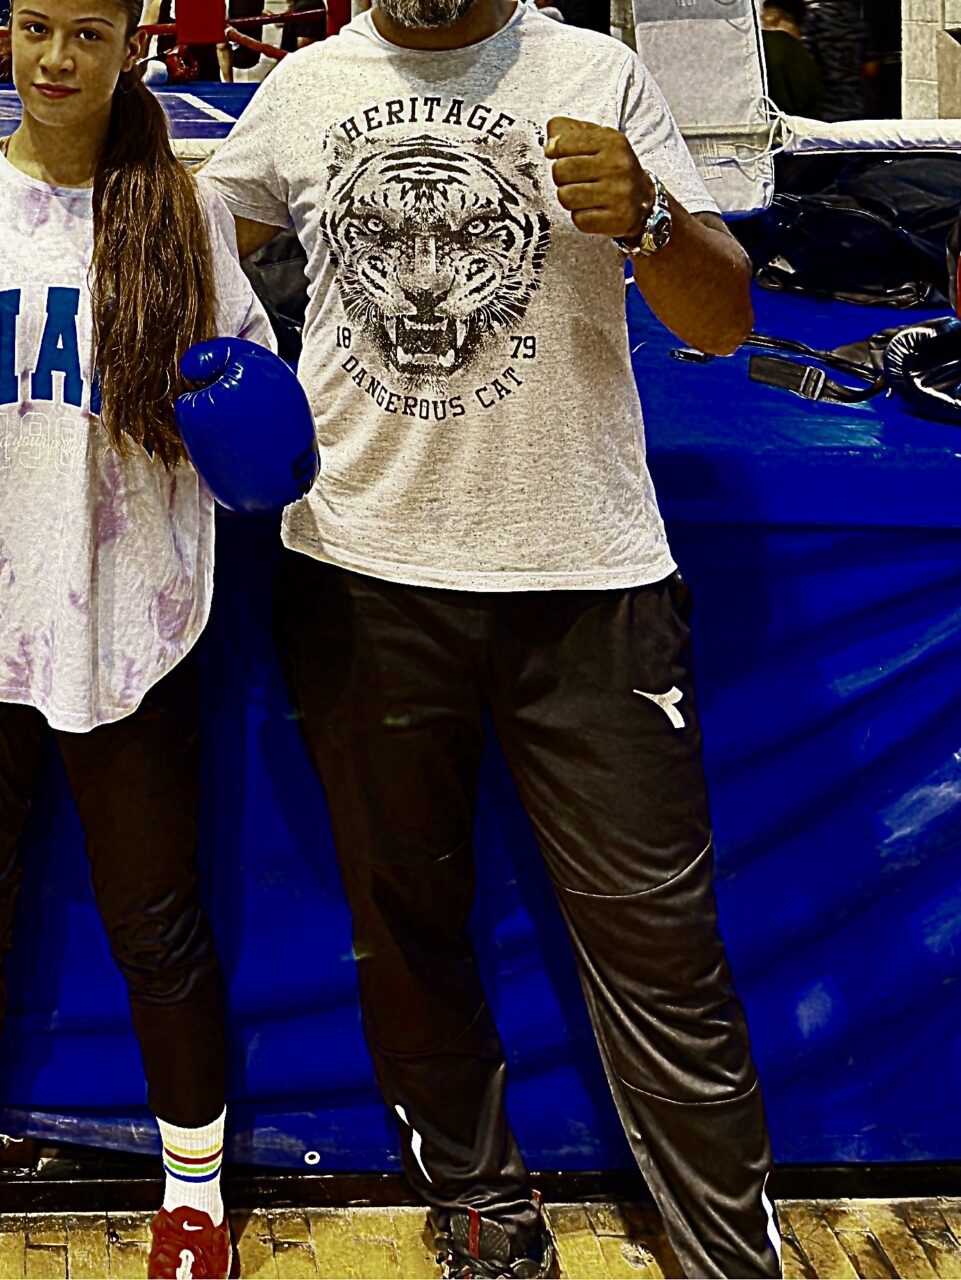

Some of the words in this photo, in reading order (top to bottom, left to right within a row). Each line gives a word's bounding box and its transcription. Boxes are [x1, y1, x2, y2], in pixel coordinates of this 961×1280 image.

[339, 96, 515, 143] HERITAGE
[336, 326, 352, 349] 18
[510, 335, 537, 359] 79
[341, 355, 466, 420] DANGEROUS
[475, 366, 524, 409] CAT
